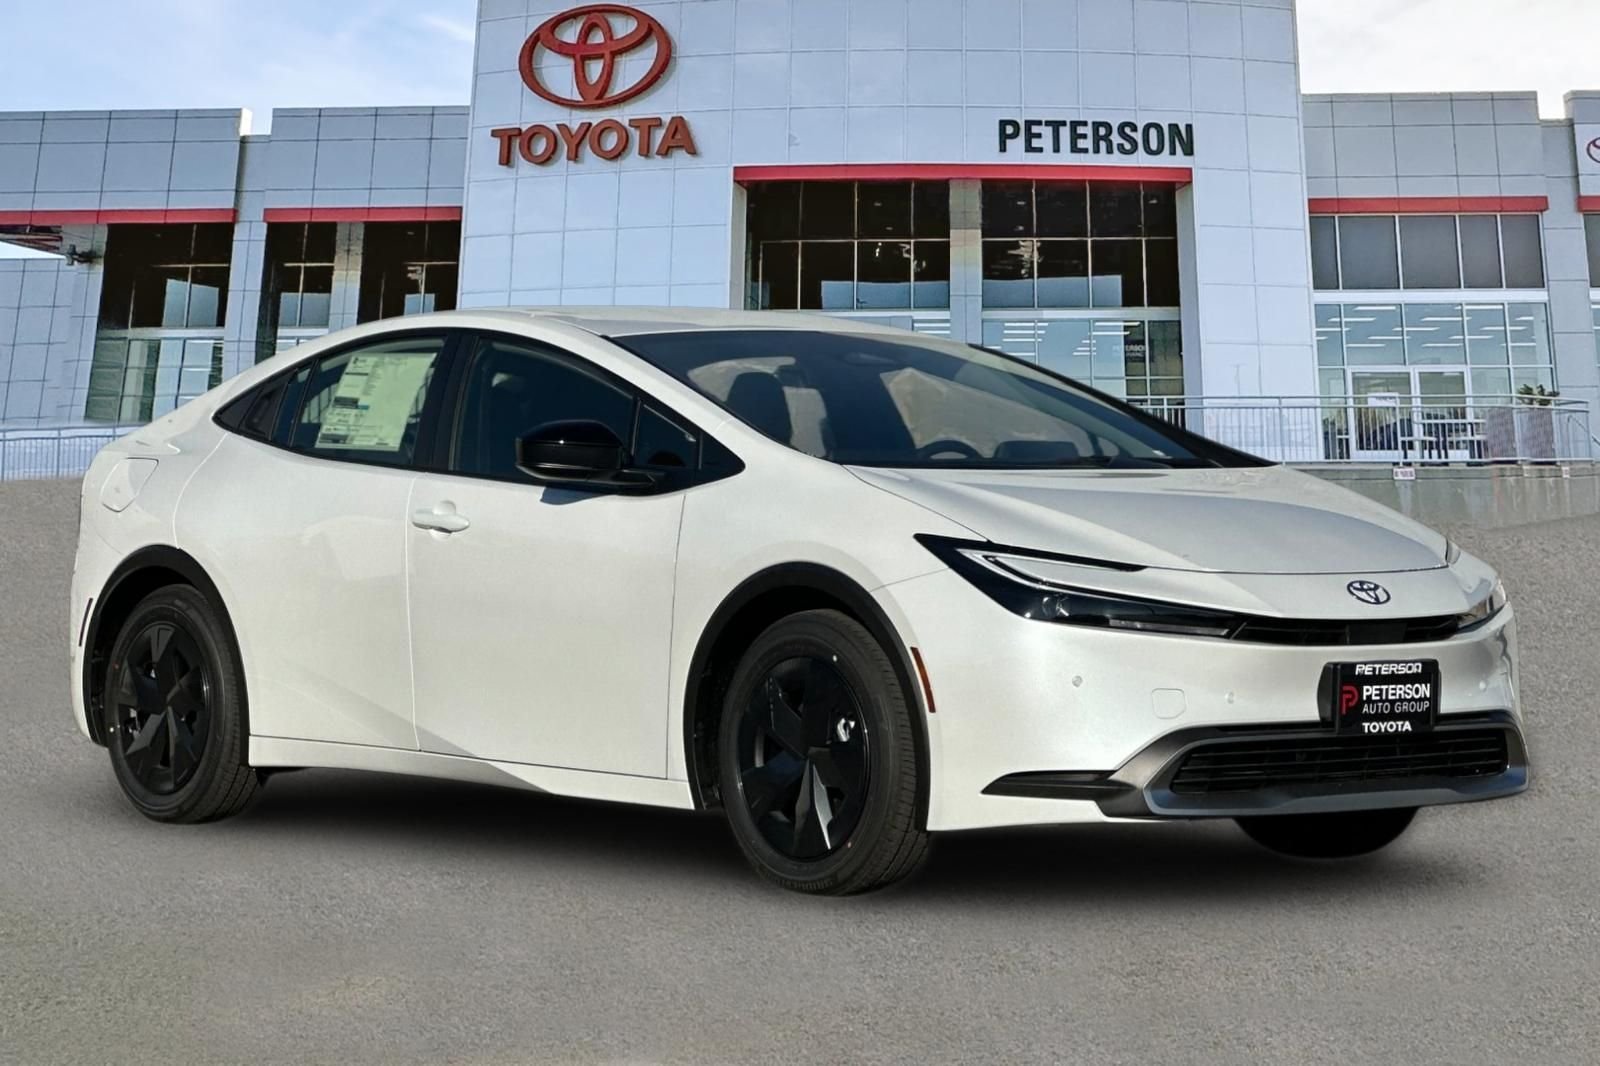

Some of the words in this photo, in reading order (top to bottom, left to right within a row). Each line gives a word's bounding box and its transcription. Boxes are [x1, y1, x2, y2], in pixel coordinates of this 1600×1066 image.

[491, 116, 697, 166] TOYOTA
[998, 119, 1194, 156] PETERSON
[1355, 663, 1422, 675] PETERSON
[1363, 683, 1430, 700] PETERSON
[1362, 702, 1391, 714] AUTO
[1394, 701, 1430, 713] GROUP
[1362, 721, 1412, 733] TOYOTA
